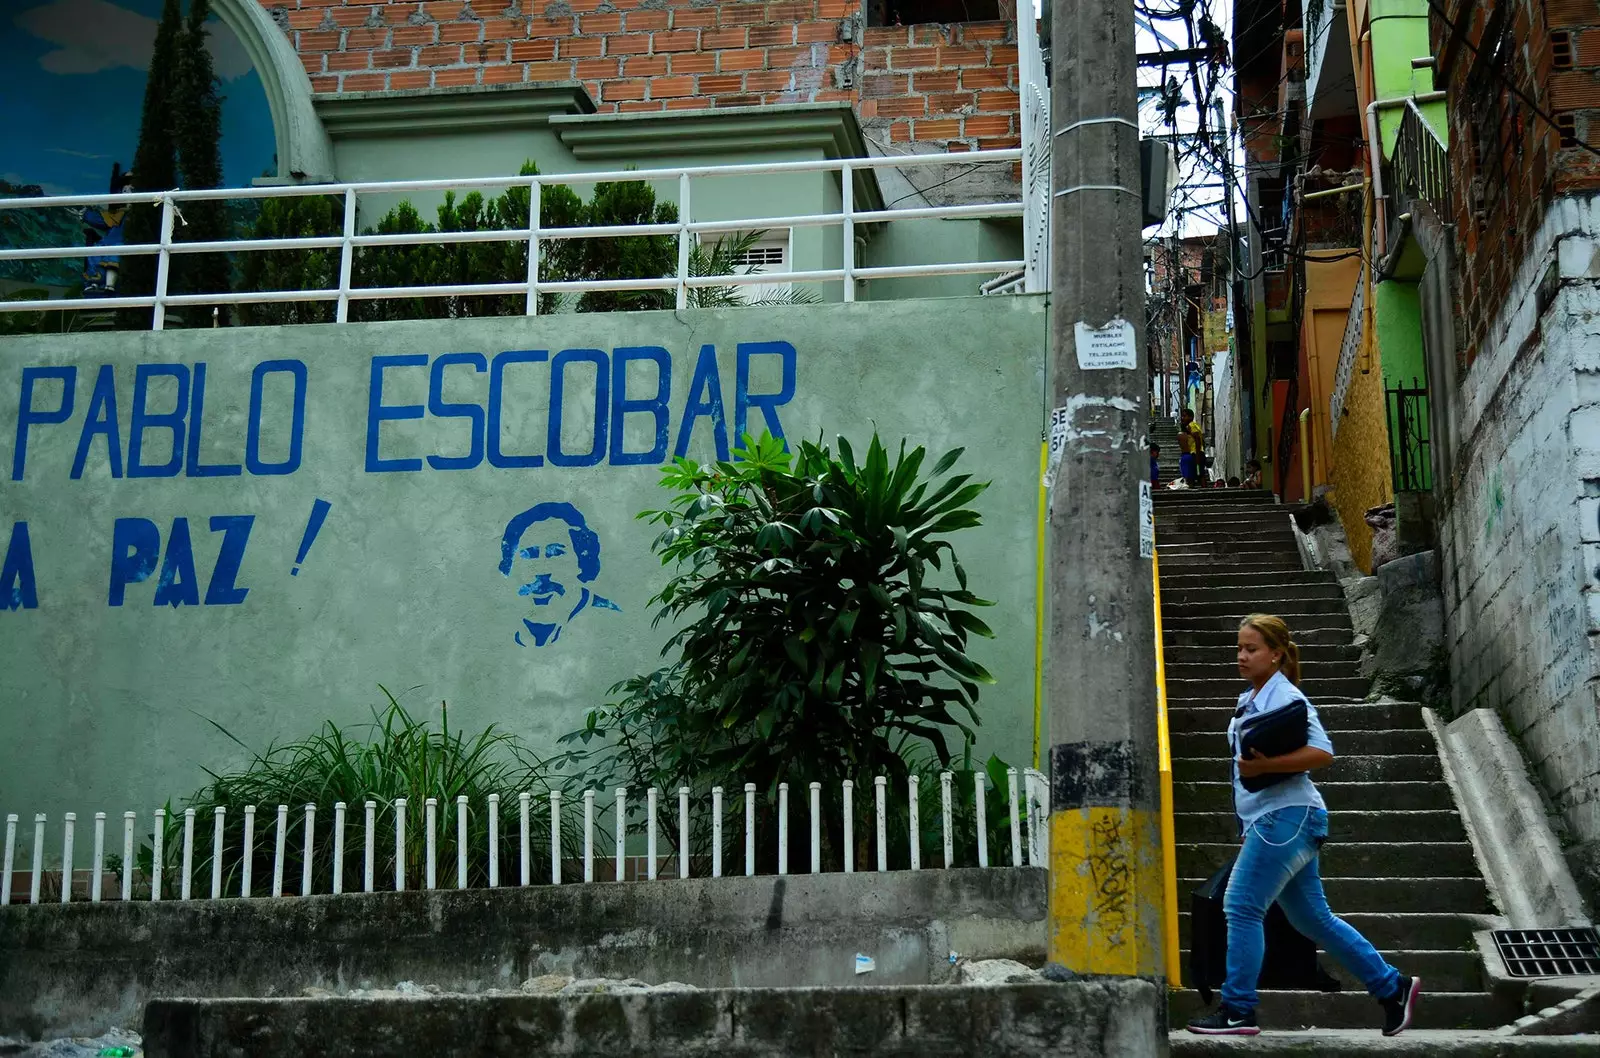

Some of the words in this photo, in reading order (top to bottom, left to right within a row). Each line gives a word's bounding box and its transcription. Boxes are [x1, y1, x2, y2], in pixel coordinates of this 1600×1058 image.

[12, 358, 308, 481] PABLO
[365, 341, 797, 474] ESCOBAR
[0, 521, 39, 612] A
[108, 515, 256, 609] PAZ
